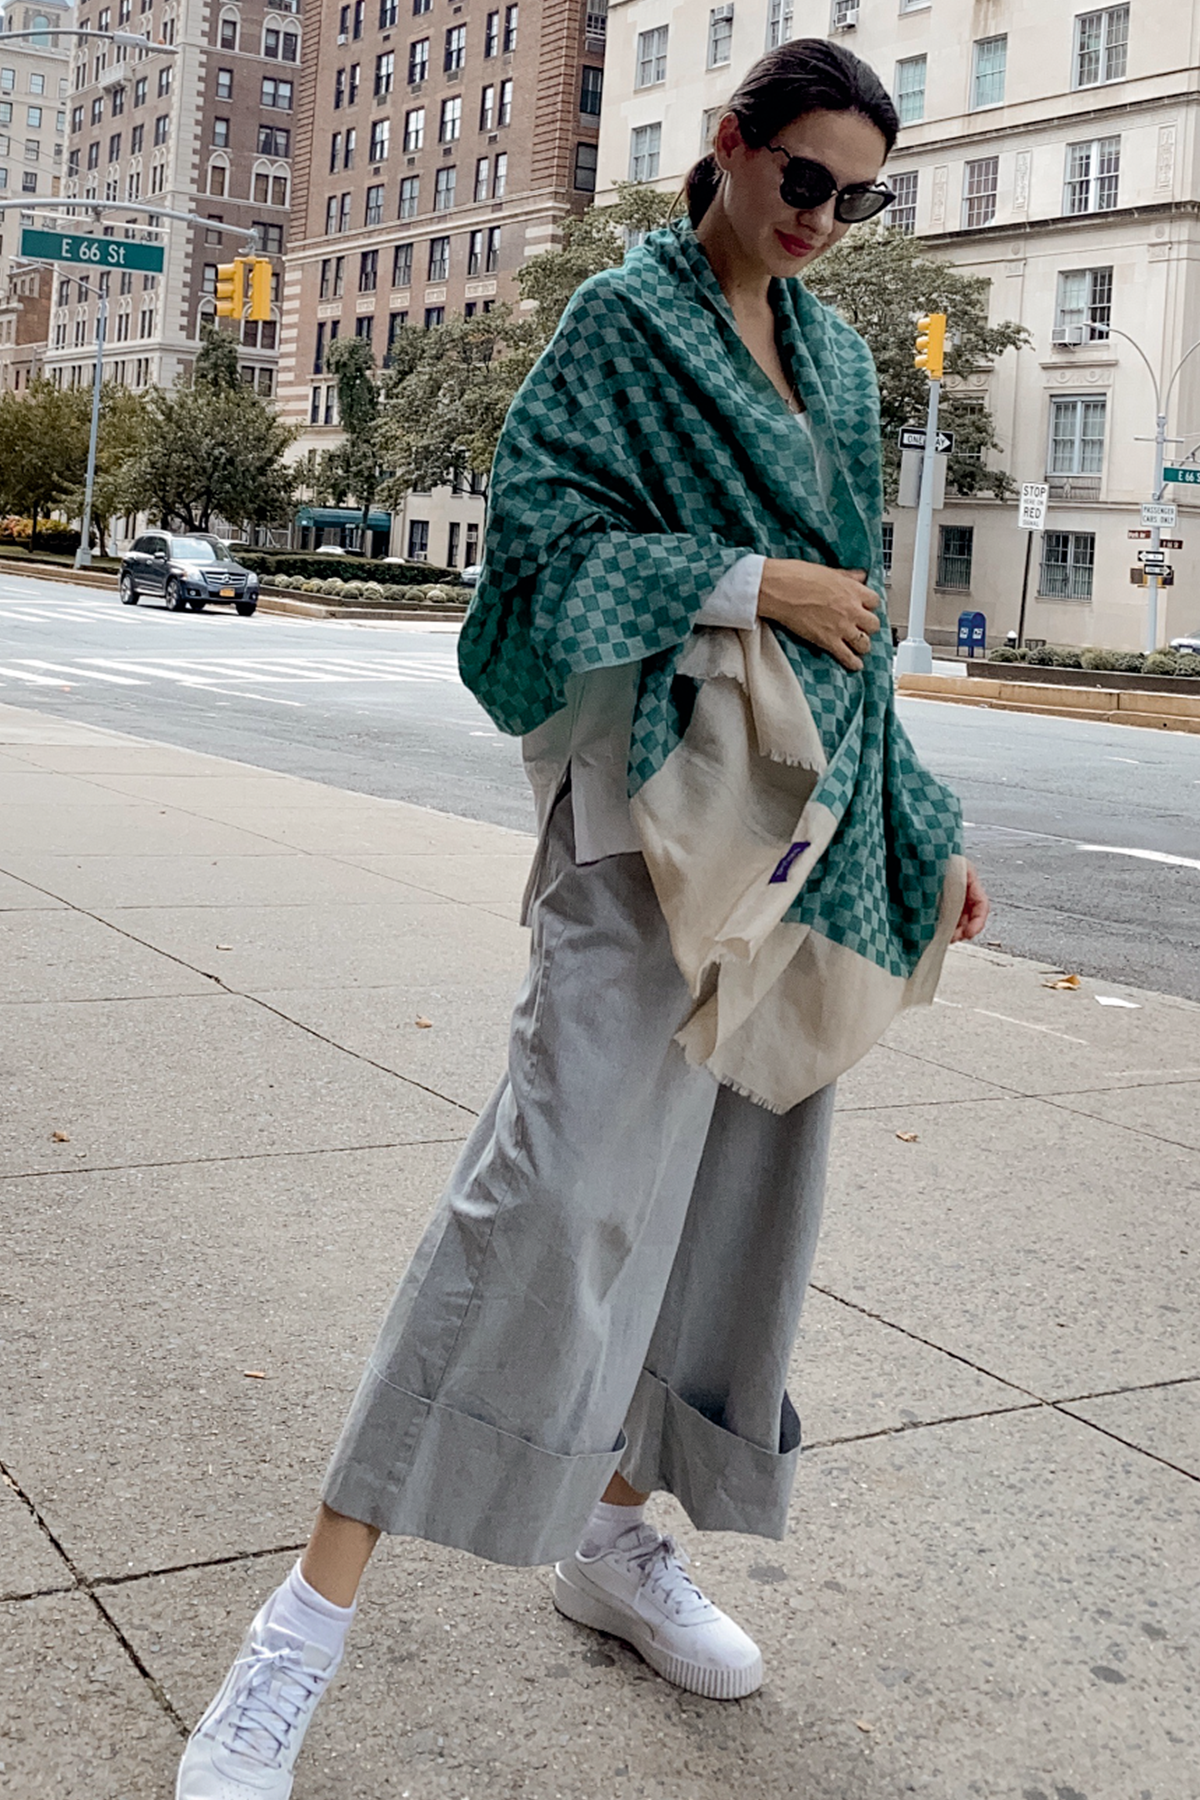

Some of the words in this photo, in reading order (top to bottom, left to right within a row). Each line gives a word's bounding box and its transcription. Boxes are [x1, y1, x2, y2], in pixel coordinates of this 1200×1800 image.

[61, 238, 72, 257] E
[79, 240, 100, 261] 66
[107, 244, 126, 264] St
[1178, 470, 1184, 481] E
[1185, 471, 1195, 482] 66
[1023, 485, 1046, 498] STOP
[1023, 506, 1041, 519] RED
[1143, 506, 1174, 515] PASSENGER
[1143, 515, 1157, 523] CARS
[1160, 516, 1174, 524] ONLY
